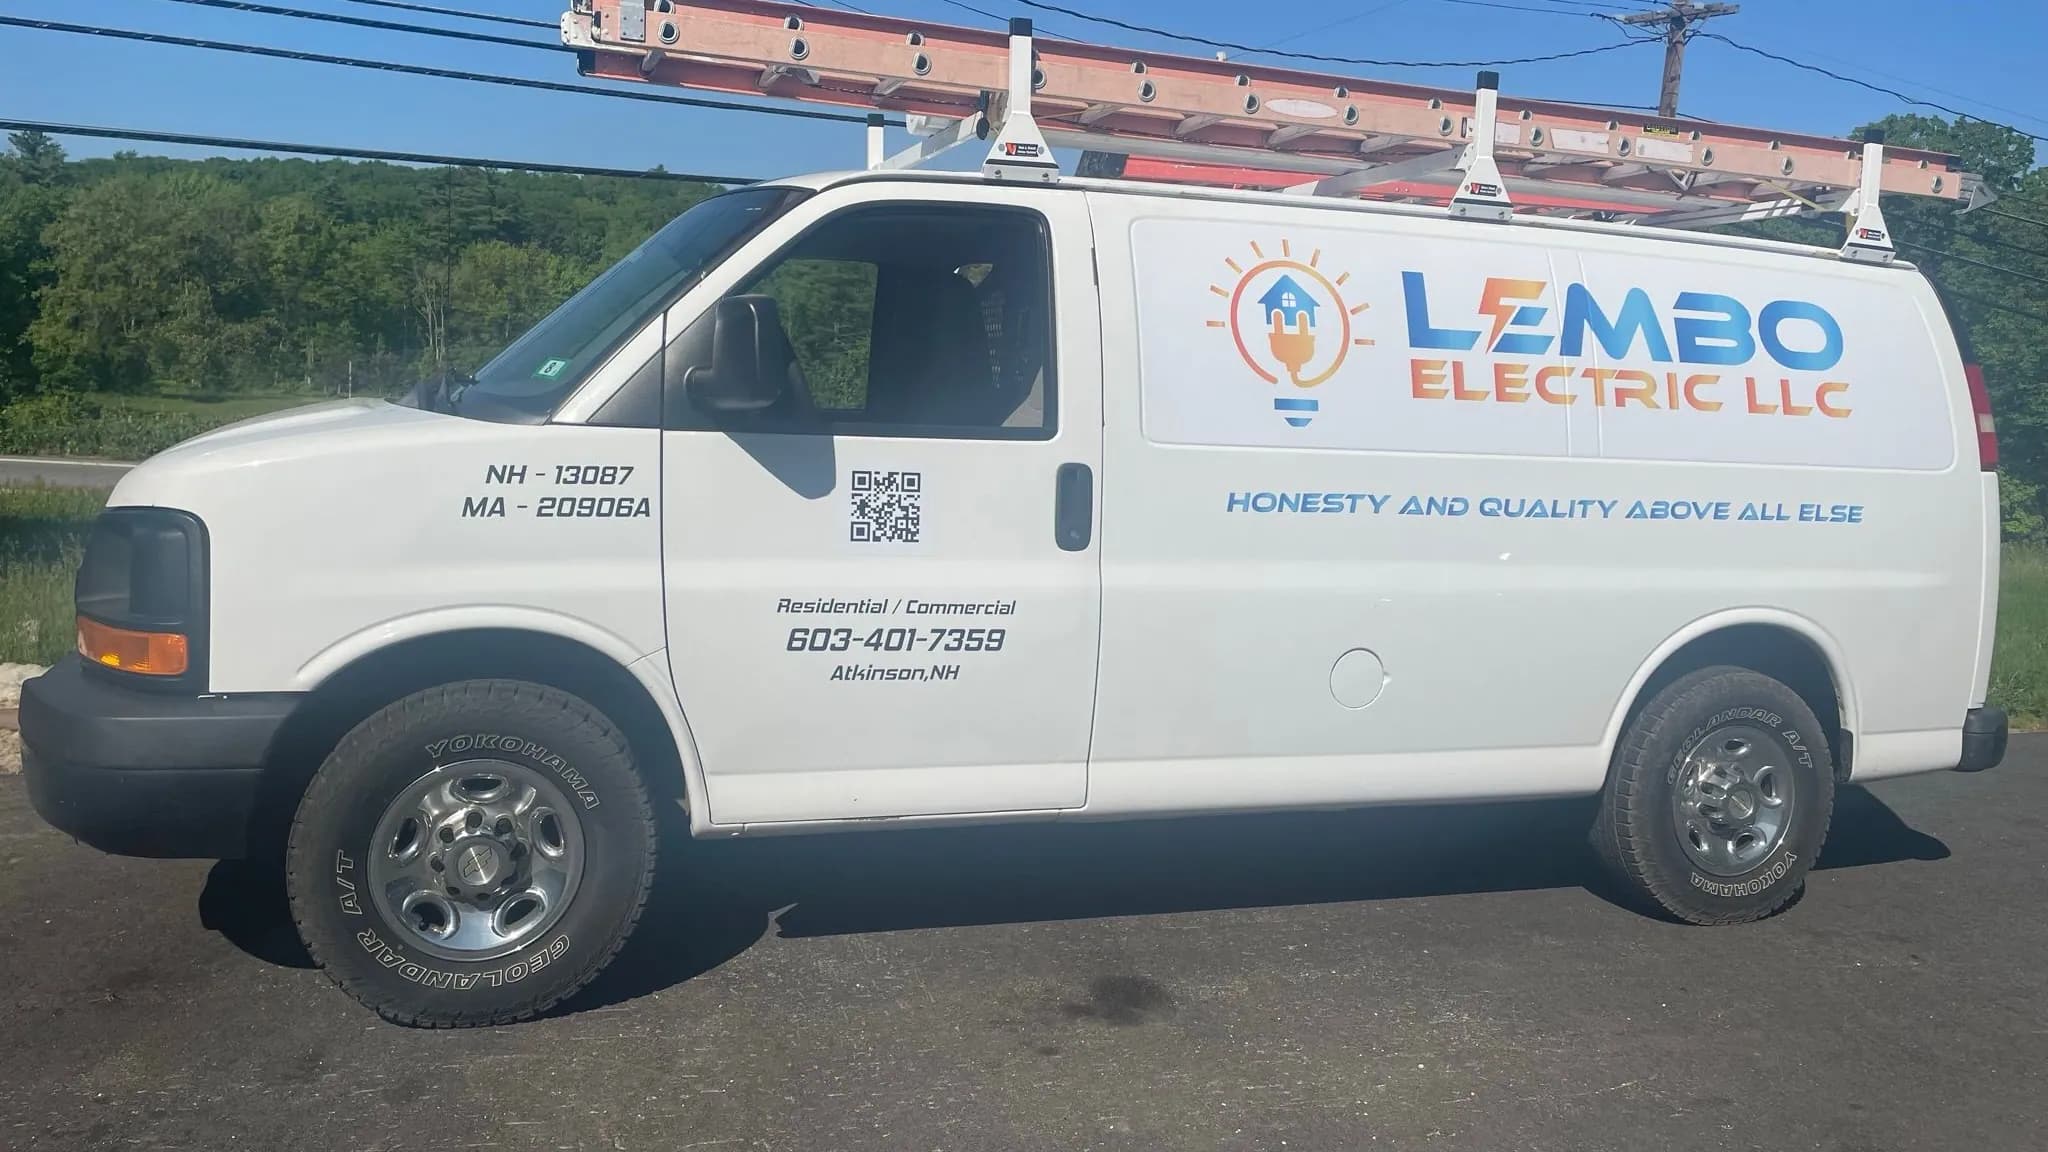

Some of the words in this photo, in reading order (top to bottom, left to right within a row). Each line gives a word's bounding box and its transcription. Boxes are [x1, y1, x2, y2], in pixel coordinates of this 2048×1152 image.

[1401, 271, 1844, 371] LEMBO
[1410, 358, 1724, 412] ELECTRIC
[1745, 376, 1853, 418] LLC
[485, 464, 528, 484] NH
[554, 465, 634, 485] 13087
[461, 496, 506, 517] MA
[536, 496, 650, 517] 20906A
[1226, 492, 1392, 514] HONESTY
[1398, 495, 1470, 517] AND
[1479, 497, 1618, 519] QUALITY
[1625, 500, 1732, 521] ABOVE
[1737, 502, 1791, 521] ALL
[1799, 503, 1865, 523] ELSE
[777, 598, 889, 614] Residential
[906, 600, 1017, 615] Commercial
[786, 628, 1006, 652] 603-401-7359
[830, 664, 960, 682] Atkinson,NH
[1782, 730, 1813, 769] A/T
[425, 734, 601, 810] YOKOHAMA
[336, 849, 362, 915] A/T
[1690, 851, 1798, 897] YOKOHAMA
[357, 928, 570, 990] GEOLANDAR
